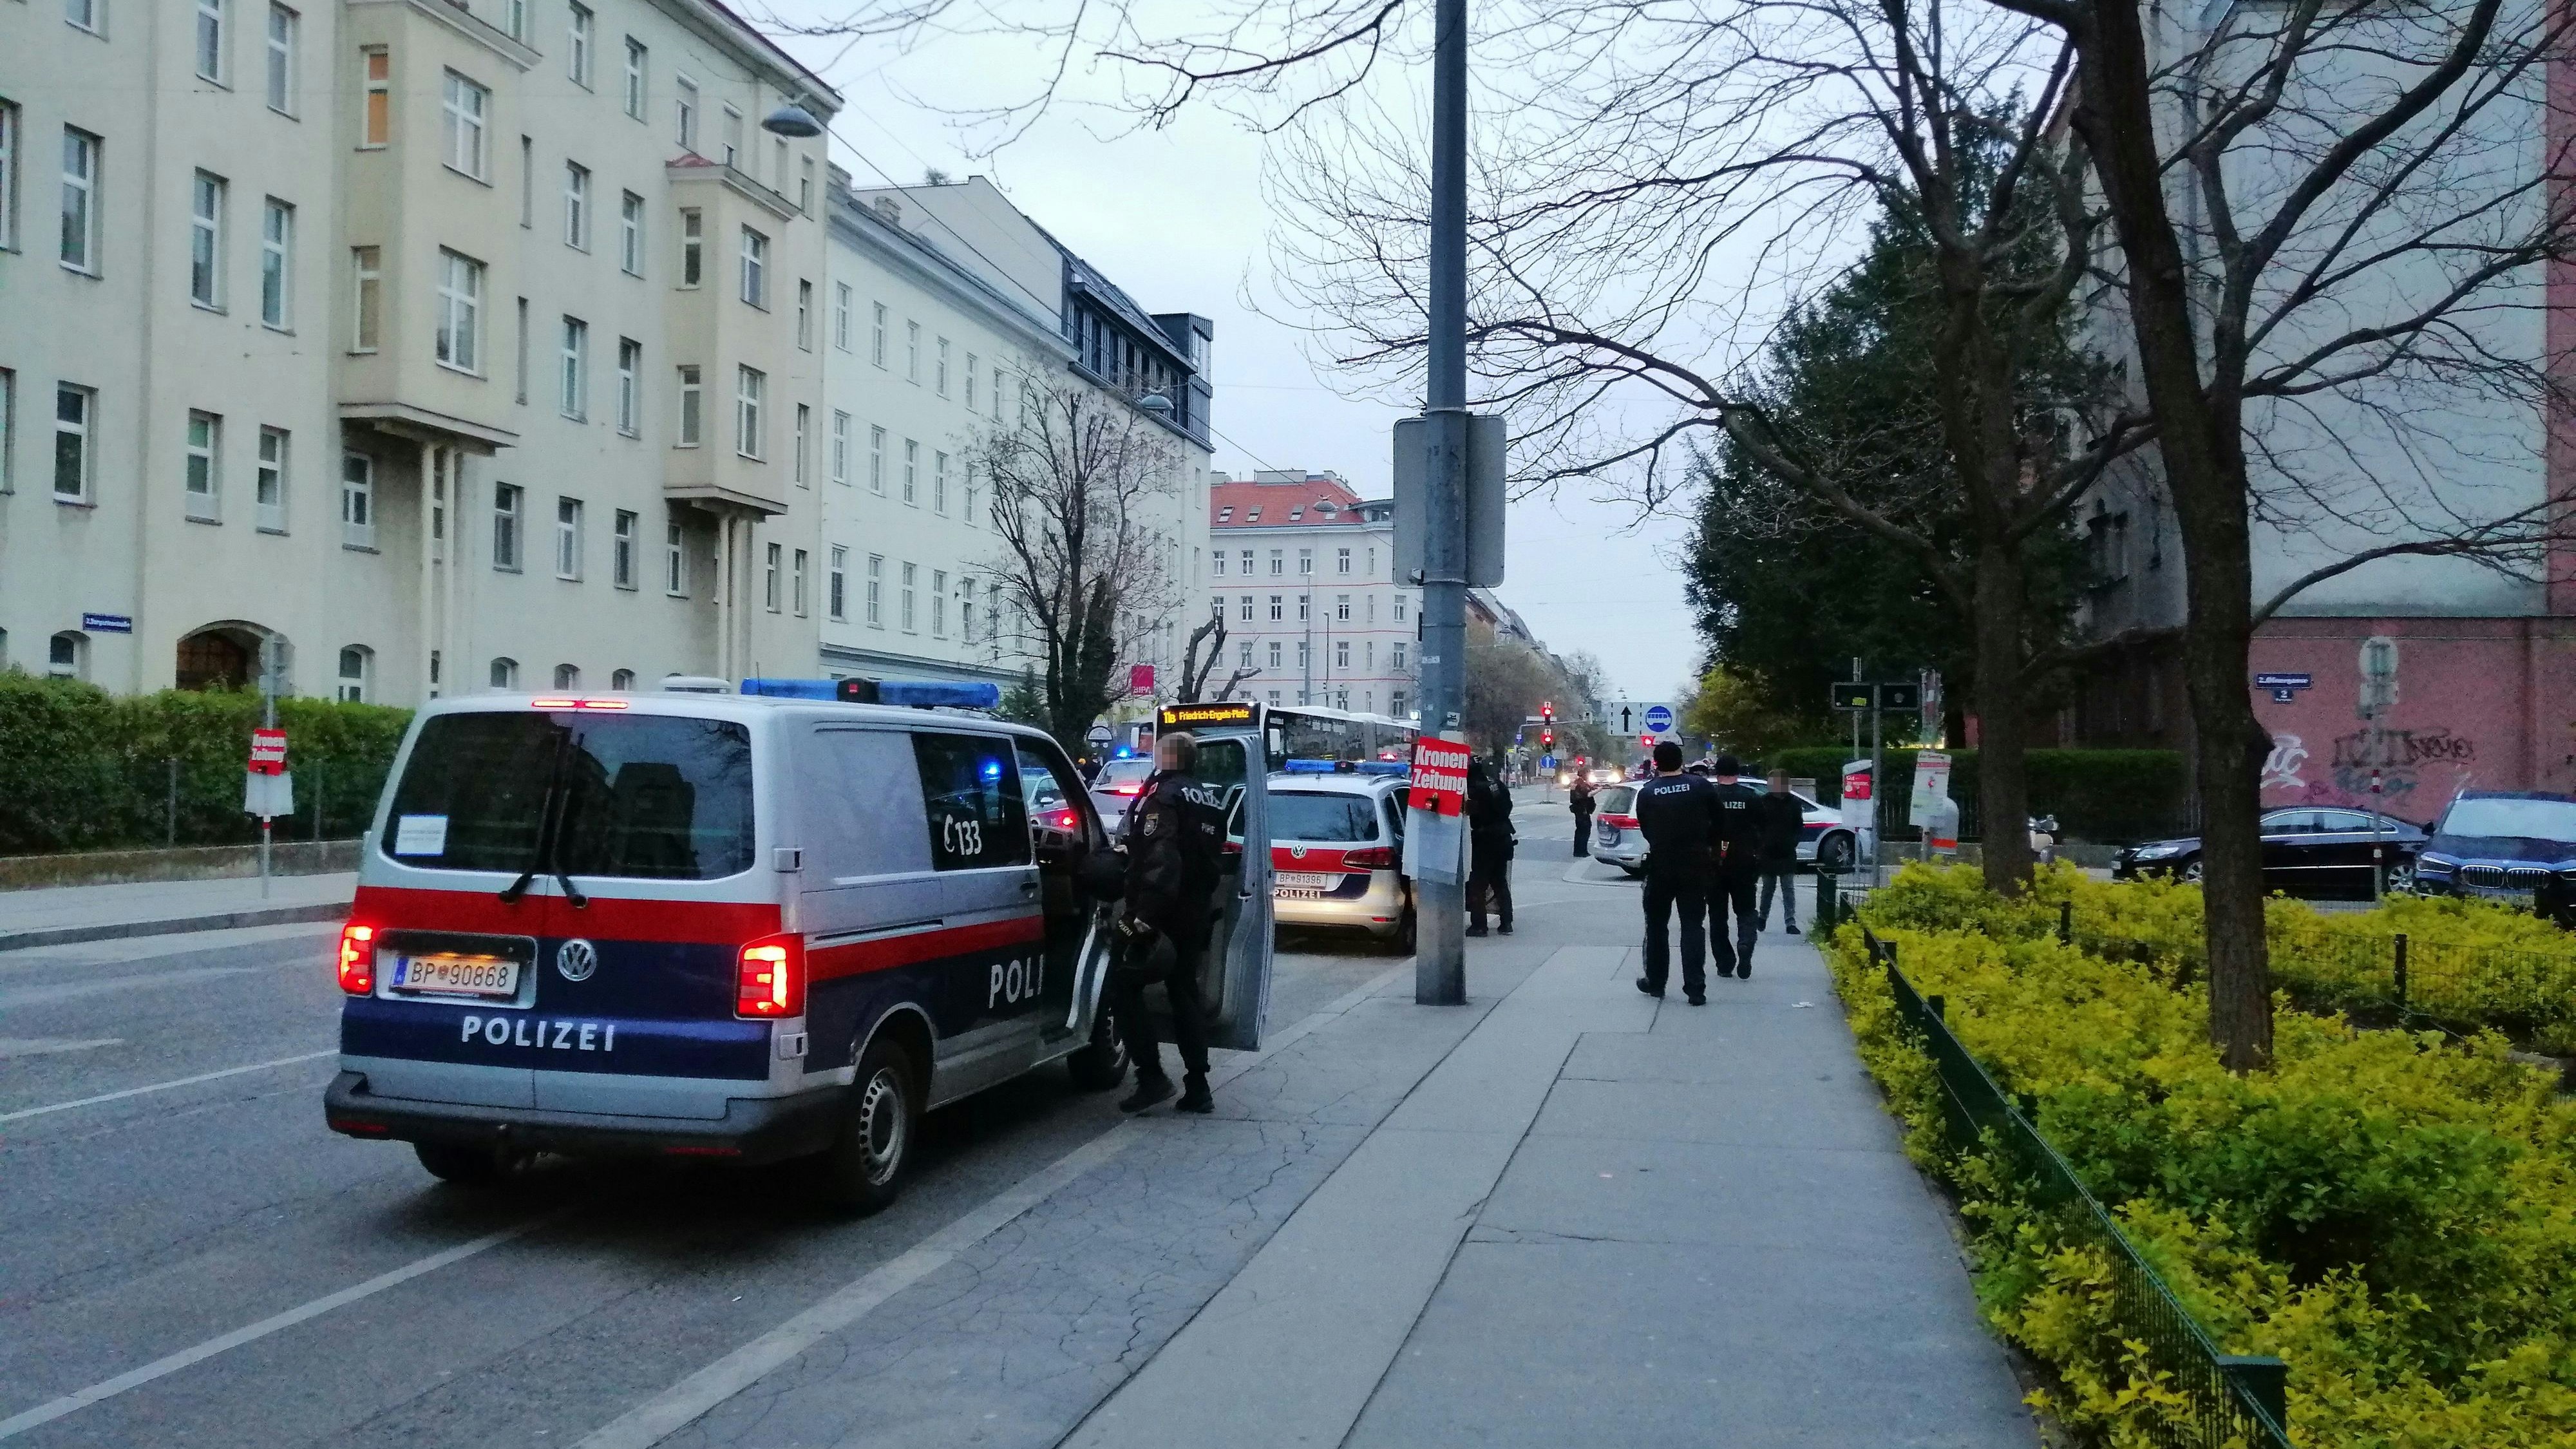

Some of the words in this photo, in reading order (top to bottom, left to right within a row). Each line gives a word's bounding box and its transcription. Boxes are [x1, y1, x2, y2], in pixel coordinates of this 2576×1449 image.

[1179, 709, 1249, 721] Friedrich-Engels-Platz
[1415, 745, 1468, 769] Kronen
[1413, 768, 1467, 795] Zeitung
[1654, 783, 1690, 795] POLIZEI
[1723, 801, 1746, 810] LIZEI
[1280, 874, 1290, 882] BP
[1296, 875, 1321, 884] 91396
[1273, 889, 1320, 899] POLIZEI
[411, 961, 435, 984] BP
[449, 964, 508, 987] 90868
[989, 954, 1044, 1009] POLI
[462, 1016, 615, 1052] POLIZEI
